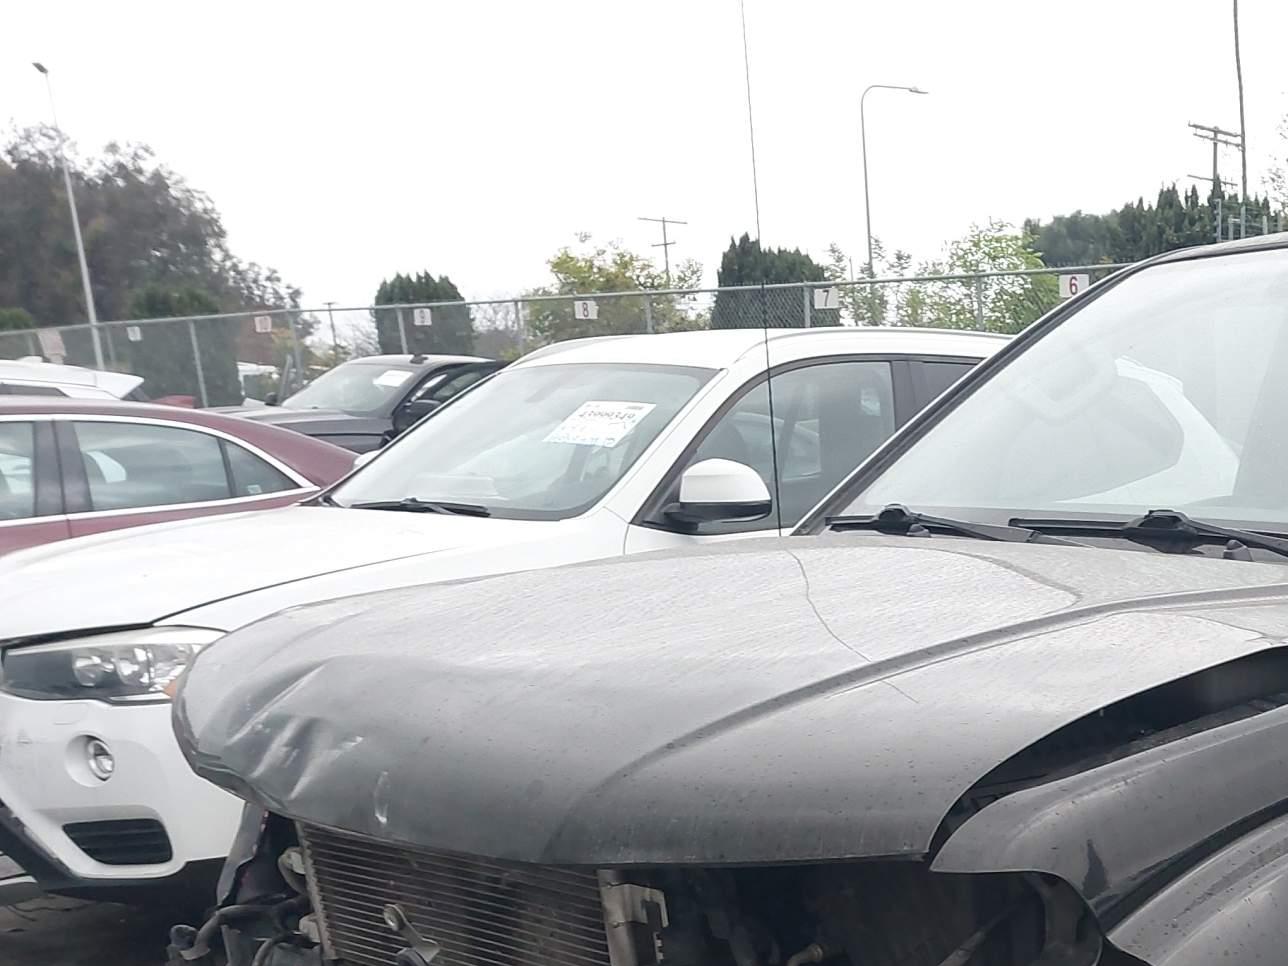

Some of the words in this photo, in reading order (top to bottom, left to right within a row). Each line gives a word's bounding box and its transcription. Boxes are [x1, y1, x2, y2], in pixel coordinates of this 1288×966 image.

[1069, 276, 1078, 296] 6
[822, 289, 830, 307] 7
[582, 302, 589, 318] 8
